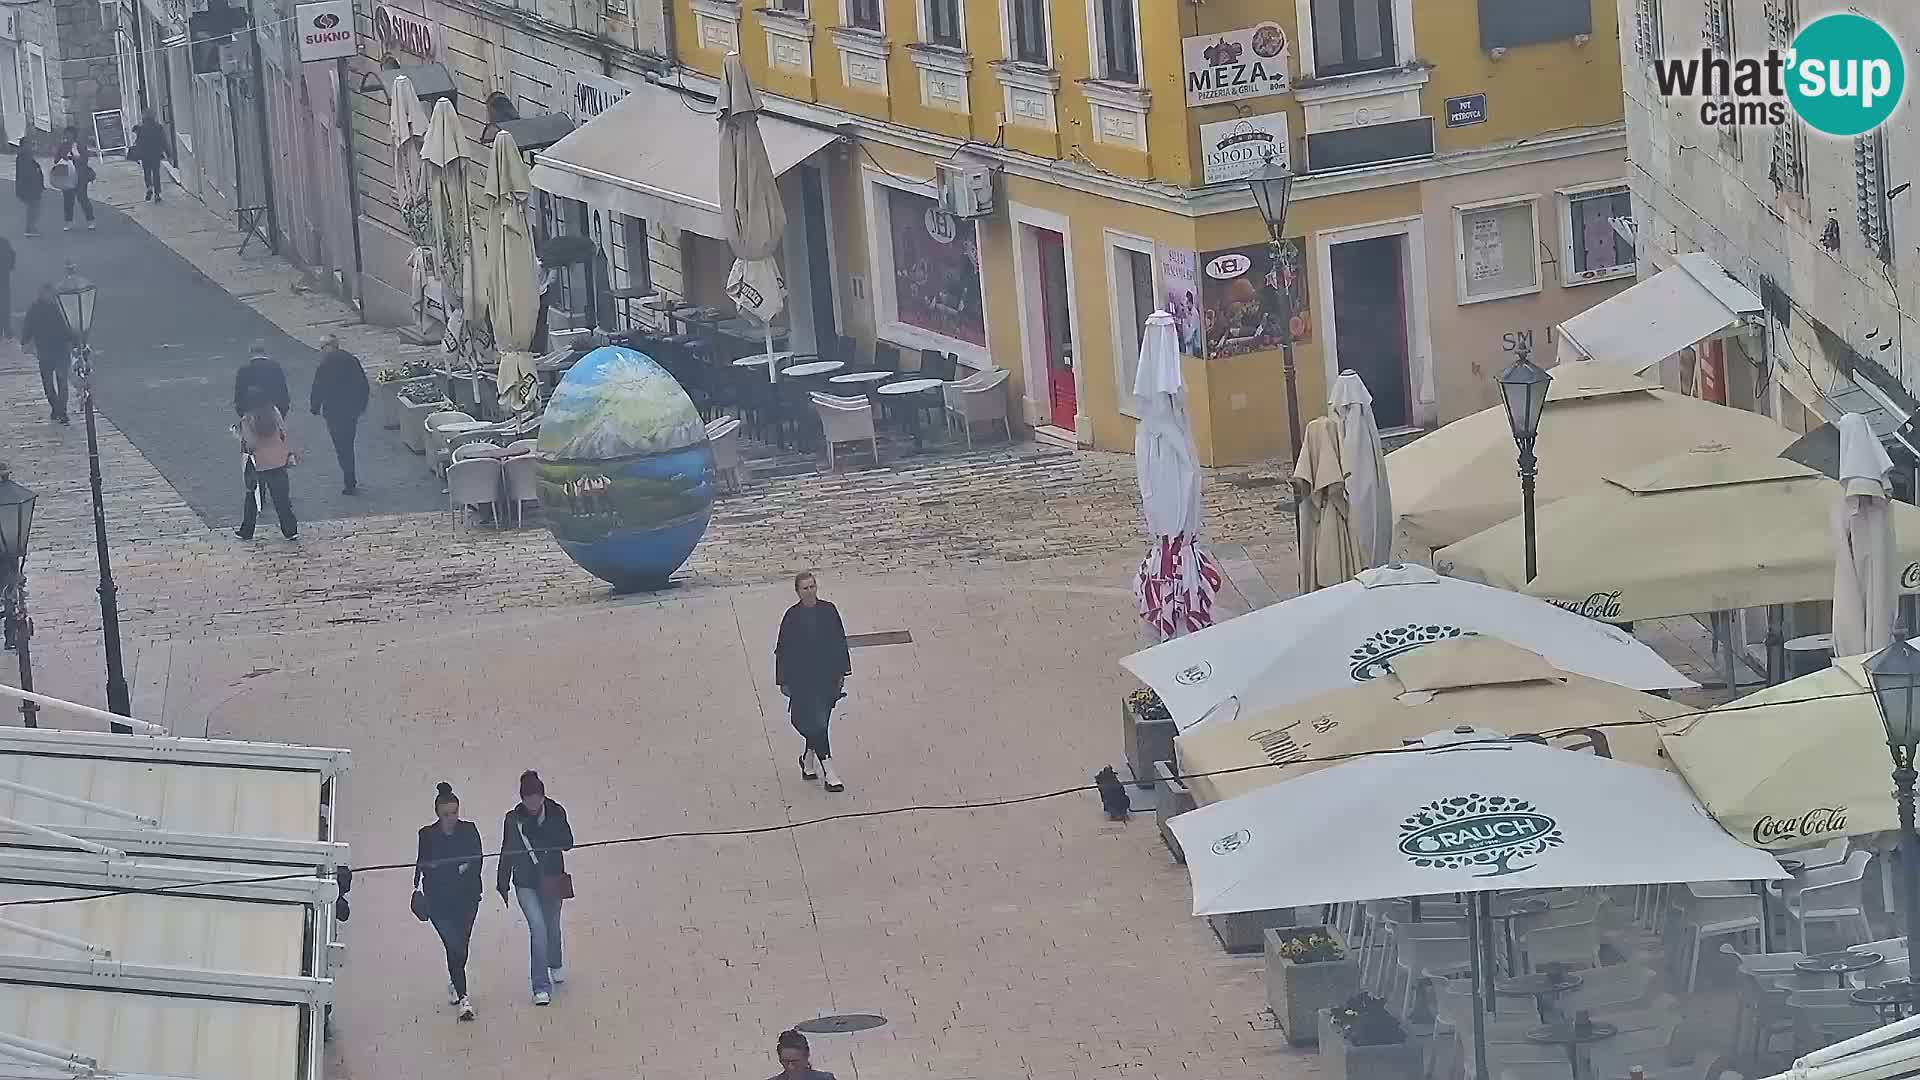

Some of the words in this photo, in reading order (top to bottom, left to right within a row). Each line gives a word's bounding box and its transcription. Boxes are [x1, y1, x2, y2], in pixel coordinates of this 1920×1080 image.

[305, 31, 350, 45] SUKNO
[1189, 61, 1267, 92] MEZA
[1198, 88, 1231, 100] PIZZERIA
[1231, 85, 1238, 95] &
[1239, 82, 1259, 94] GRILL
[1208, 148, 1253, 166] ISPOD
[1438, 818, 1538, 848] RAUCH
